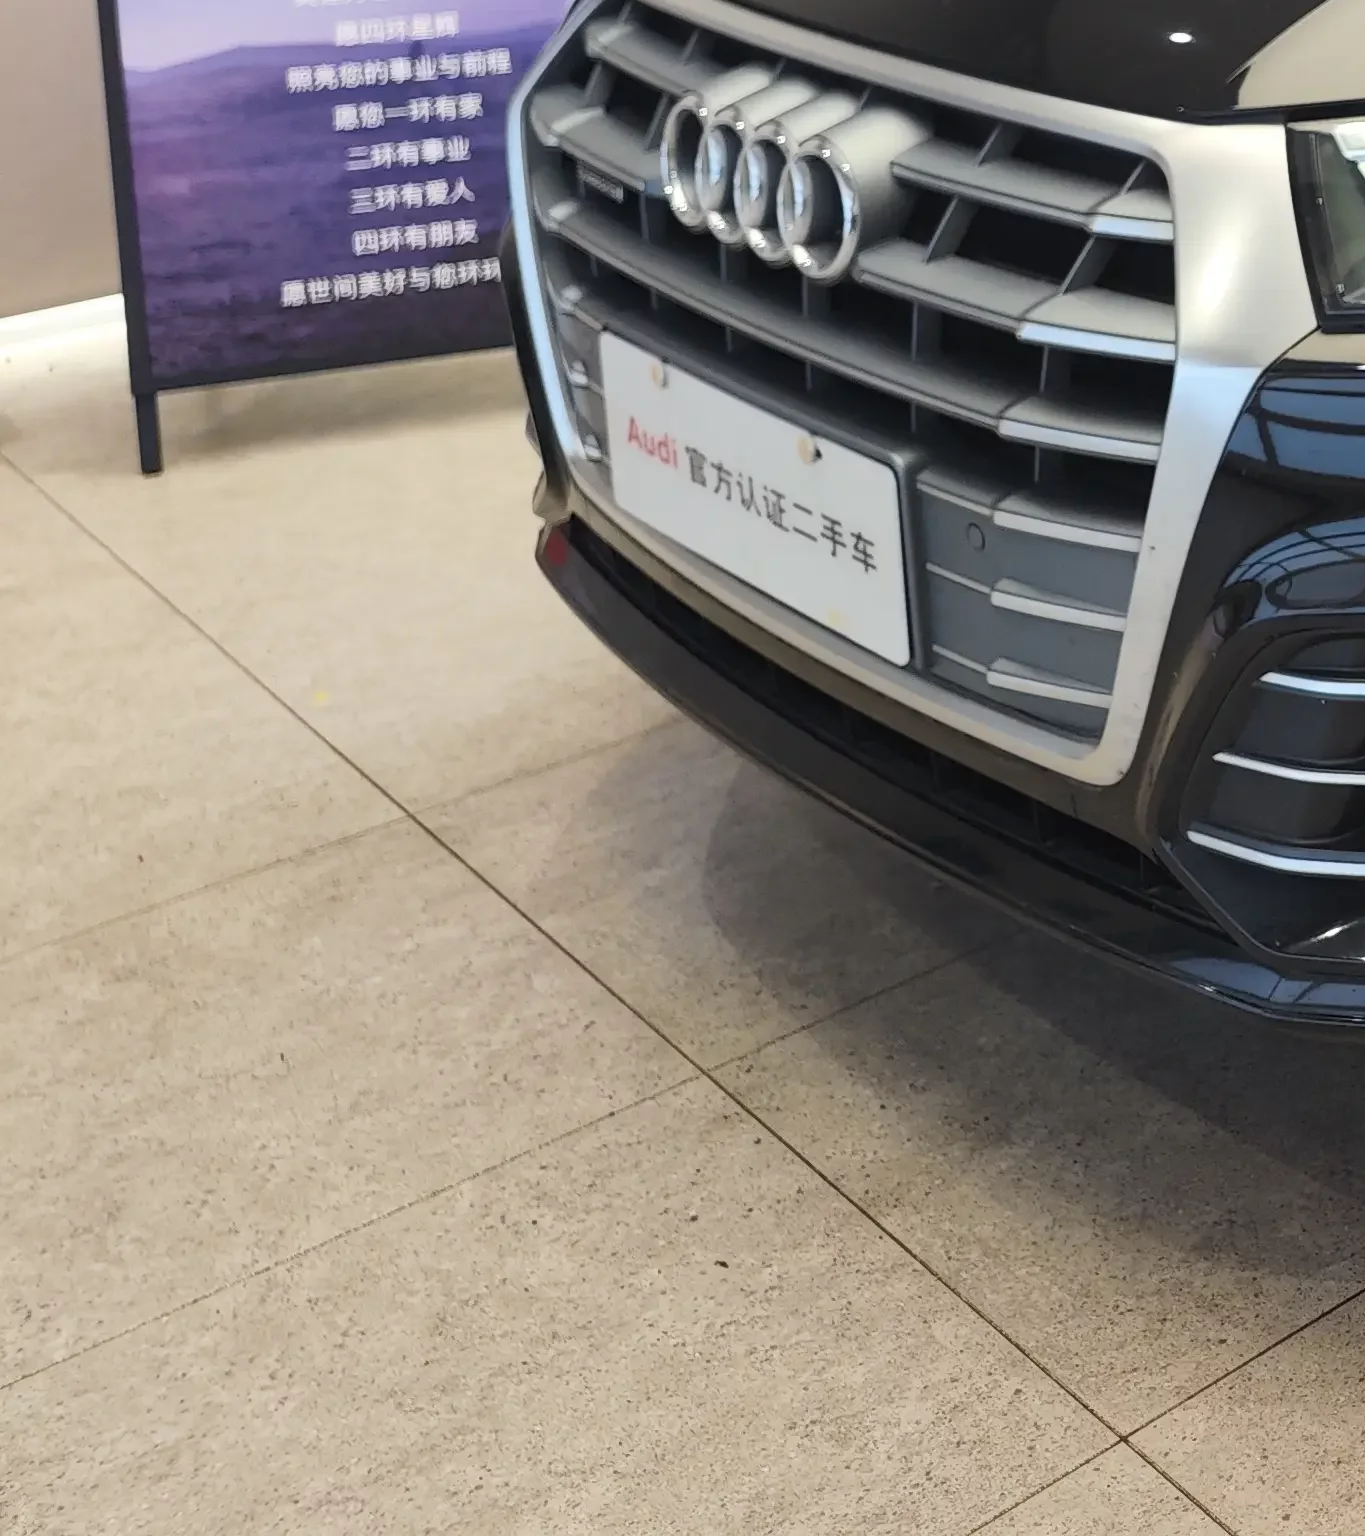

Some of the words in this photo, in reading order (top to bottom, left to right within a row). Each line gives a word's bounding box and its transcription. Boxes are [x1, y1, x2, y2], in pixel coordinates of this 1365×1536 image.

[286, 48, 512, 93] 照亮您的事业与前程
[332, 92, 483, 131] 愿您一环有家
[344, 135, 471, 171] 二环有事业
[348, 176, 475, 214] 三环有爱人
[352, 218, 479, 256] 四环有朋友
[626, 416, 679, 469] Audi
[685, 443, 877, 574] 官方认证二手车
